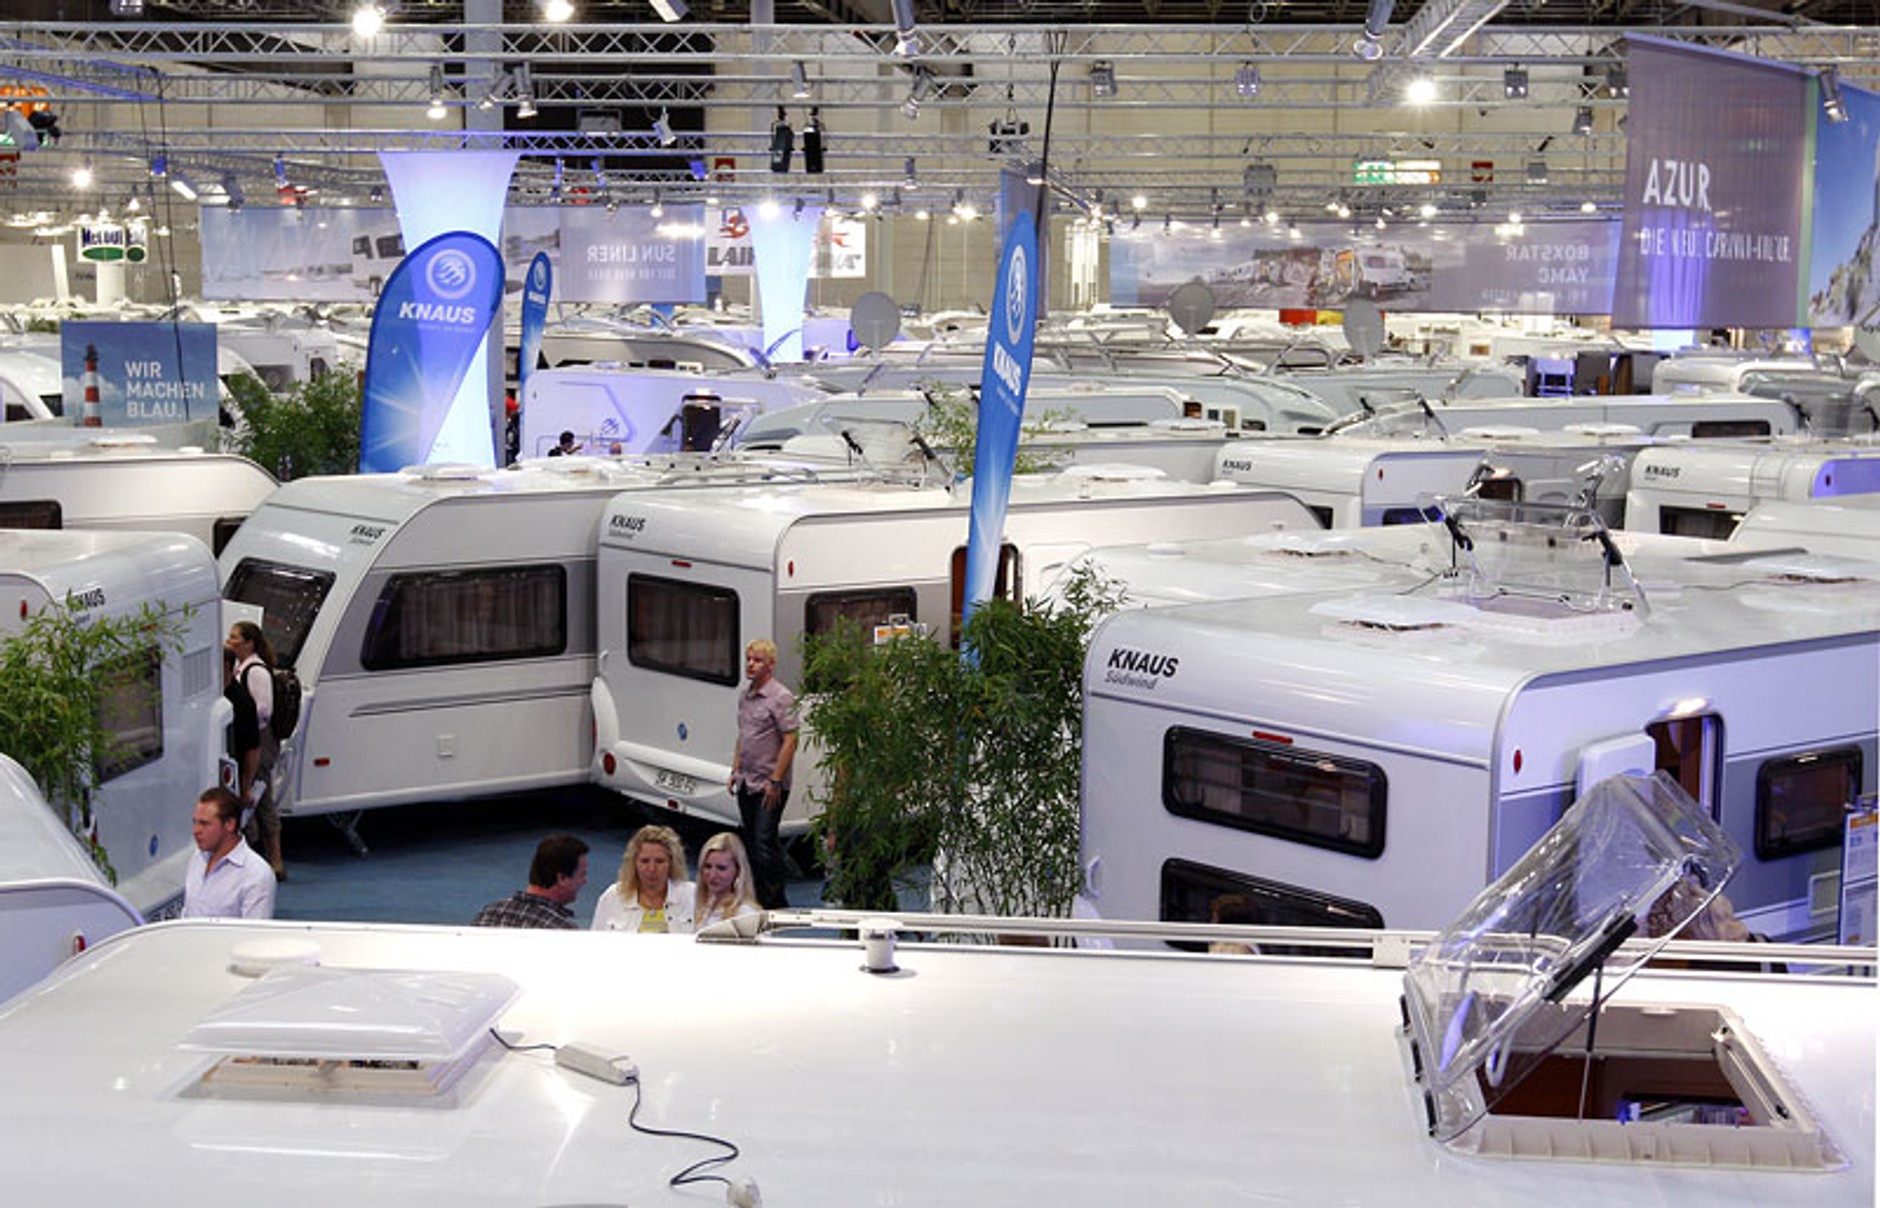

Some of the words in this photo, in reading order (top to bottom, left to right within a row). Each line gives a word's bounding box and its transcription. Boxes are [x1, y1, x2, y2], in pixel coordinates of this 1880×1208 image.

[1640, 227, 1665, 255] DIE
[1672, 228, 1702, 258] NEU
[399, 301, 476, 324] KNAUS
[125, 361, 162, 378] WIR
[127, 382, 205, 399] MACHEN
[127, 402, 182, 418] BLAU.
[609, 514, 647, 533] KNAUS
[1107, 648, 1180, 678] KNAUS
[1104, 670, 1158, 690] Südwind
